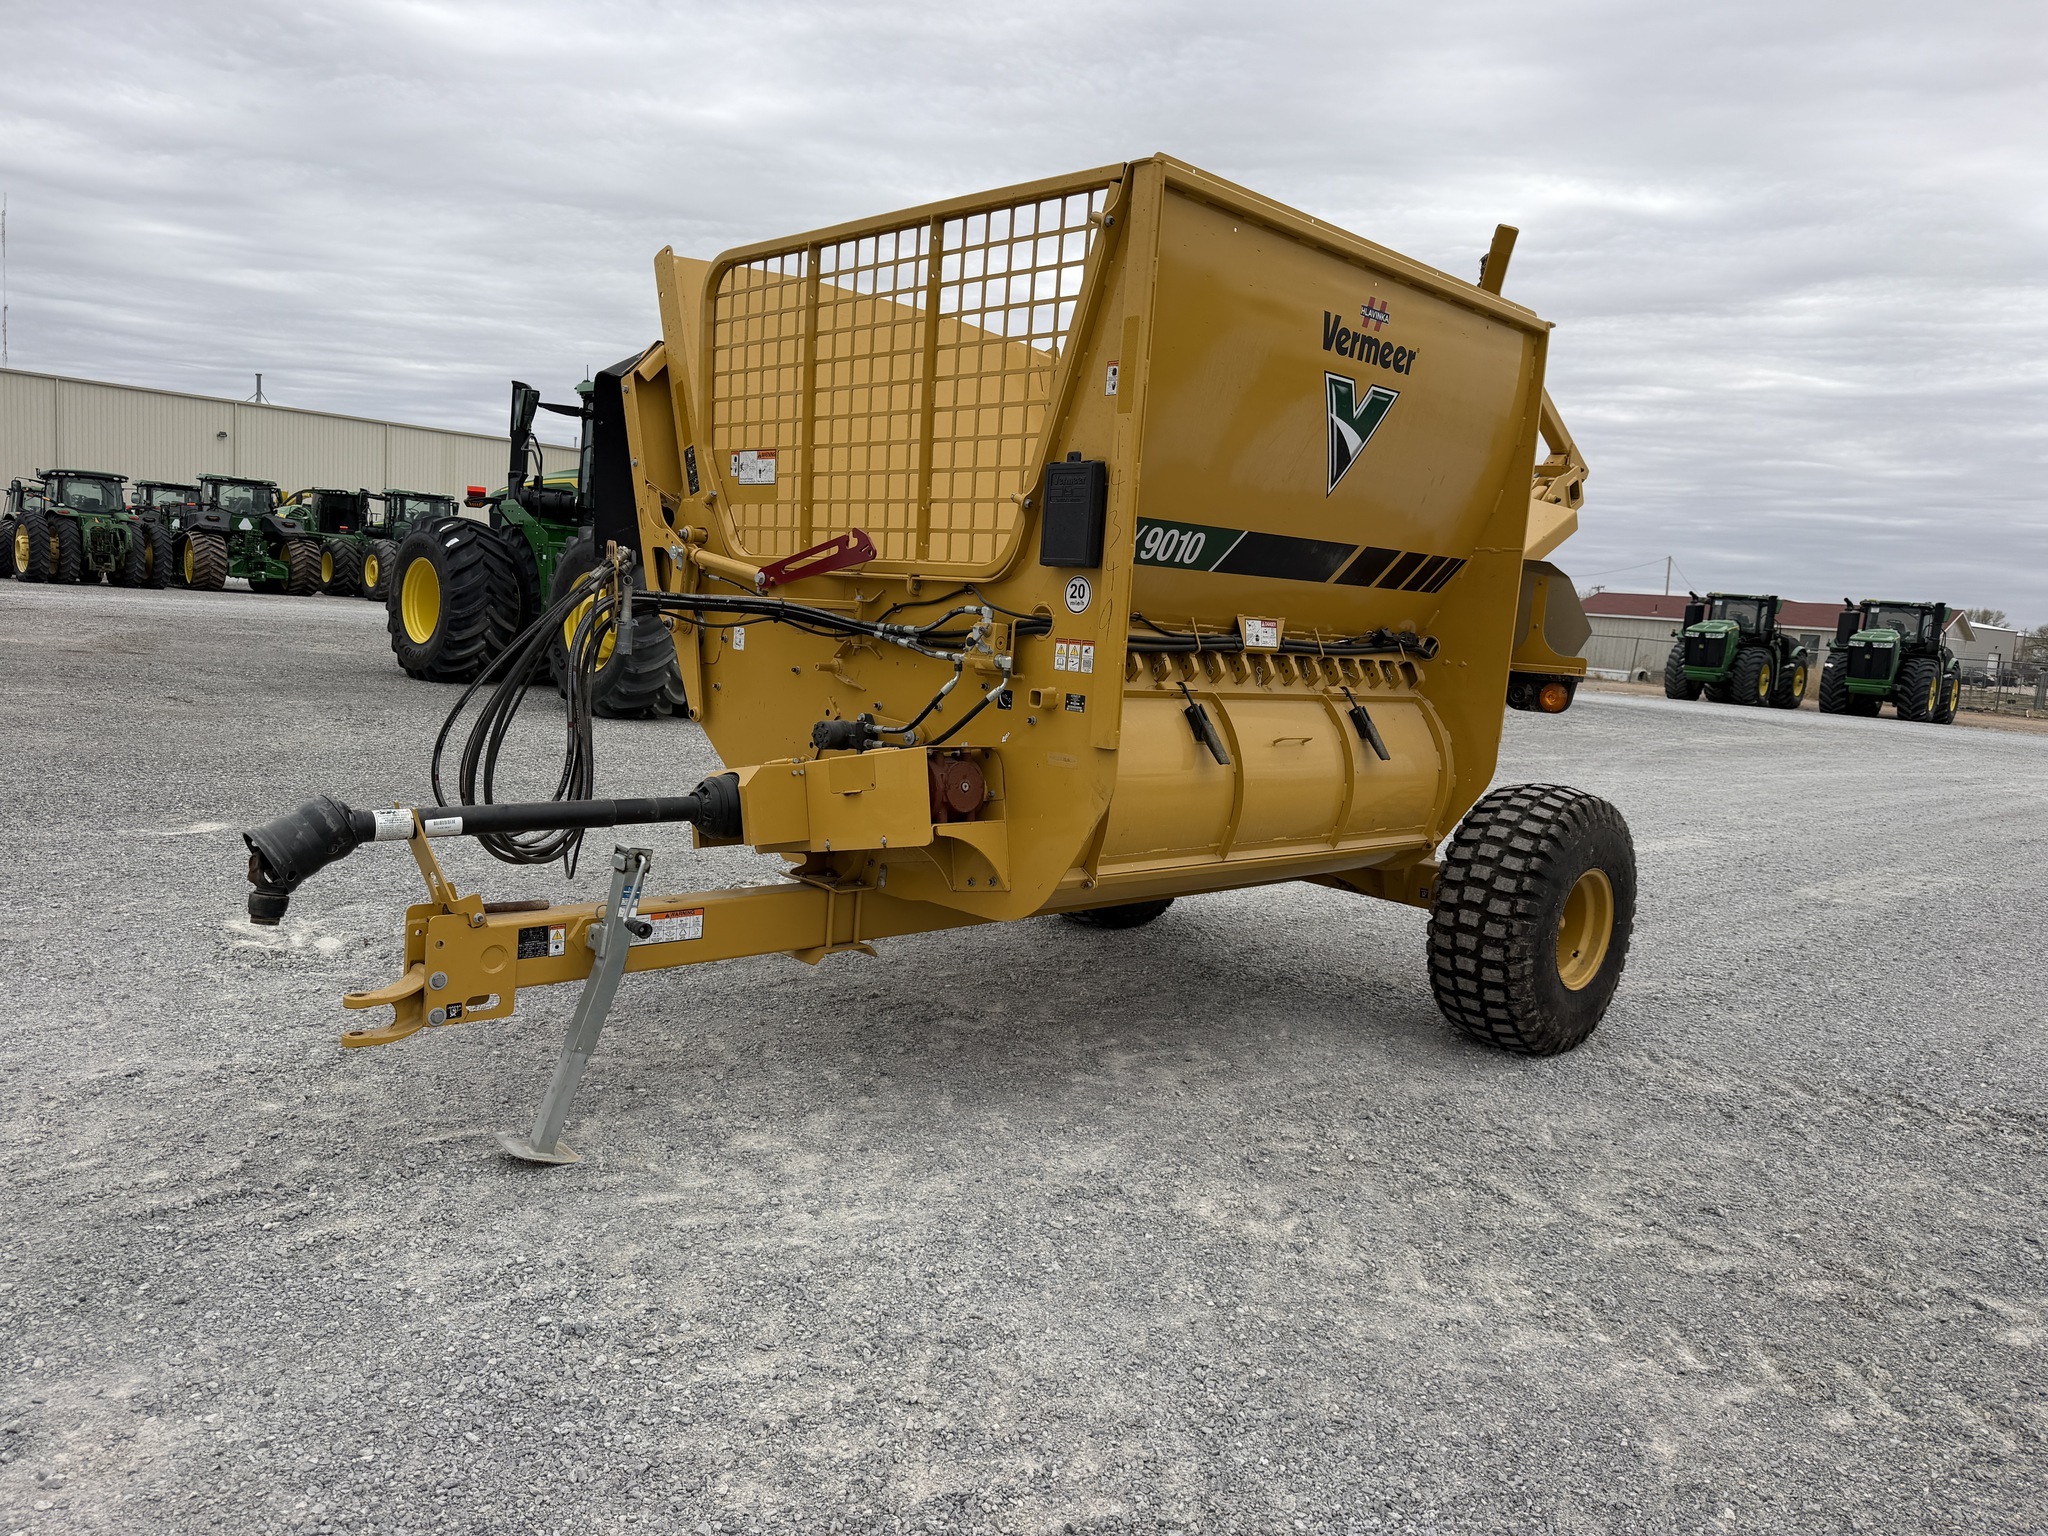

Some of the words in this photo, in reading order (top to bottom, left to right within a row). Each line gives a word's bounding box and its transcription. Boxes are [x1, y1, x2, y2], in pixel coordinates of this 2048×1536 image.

[1360, 305, 1389, 323] HLAVINKA
[1322, 310, 1416, 376] Vermeer
[1069, 583, 1086, 599] 20
[670, 910, 695, 918] WARNING
